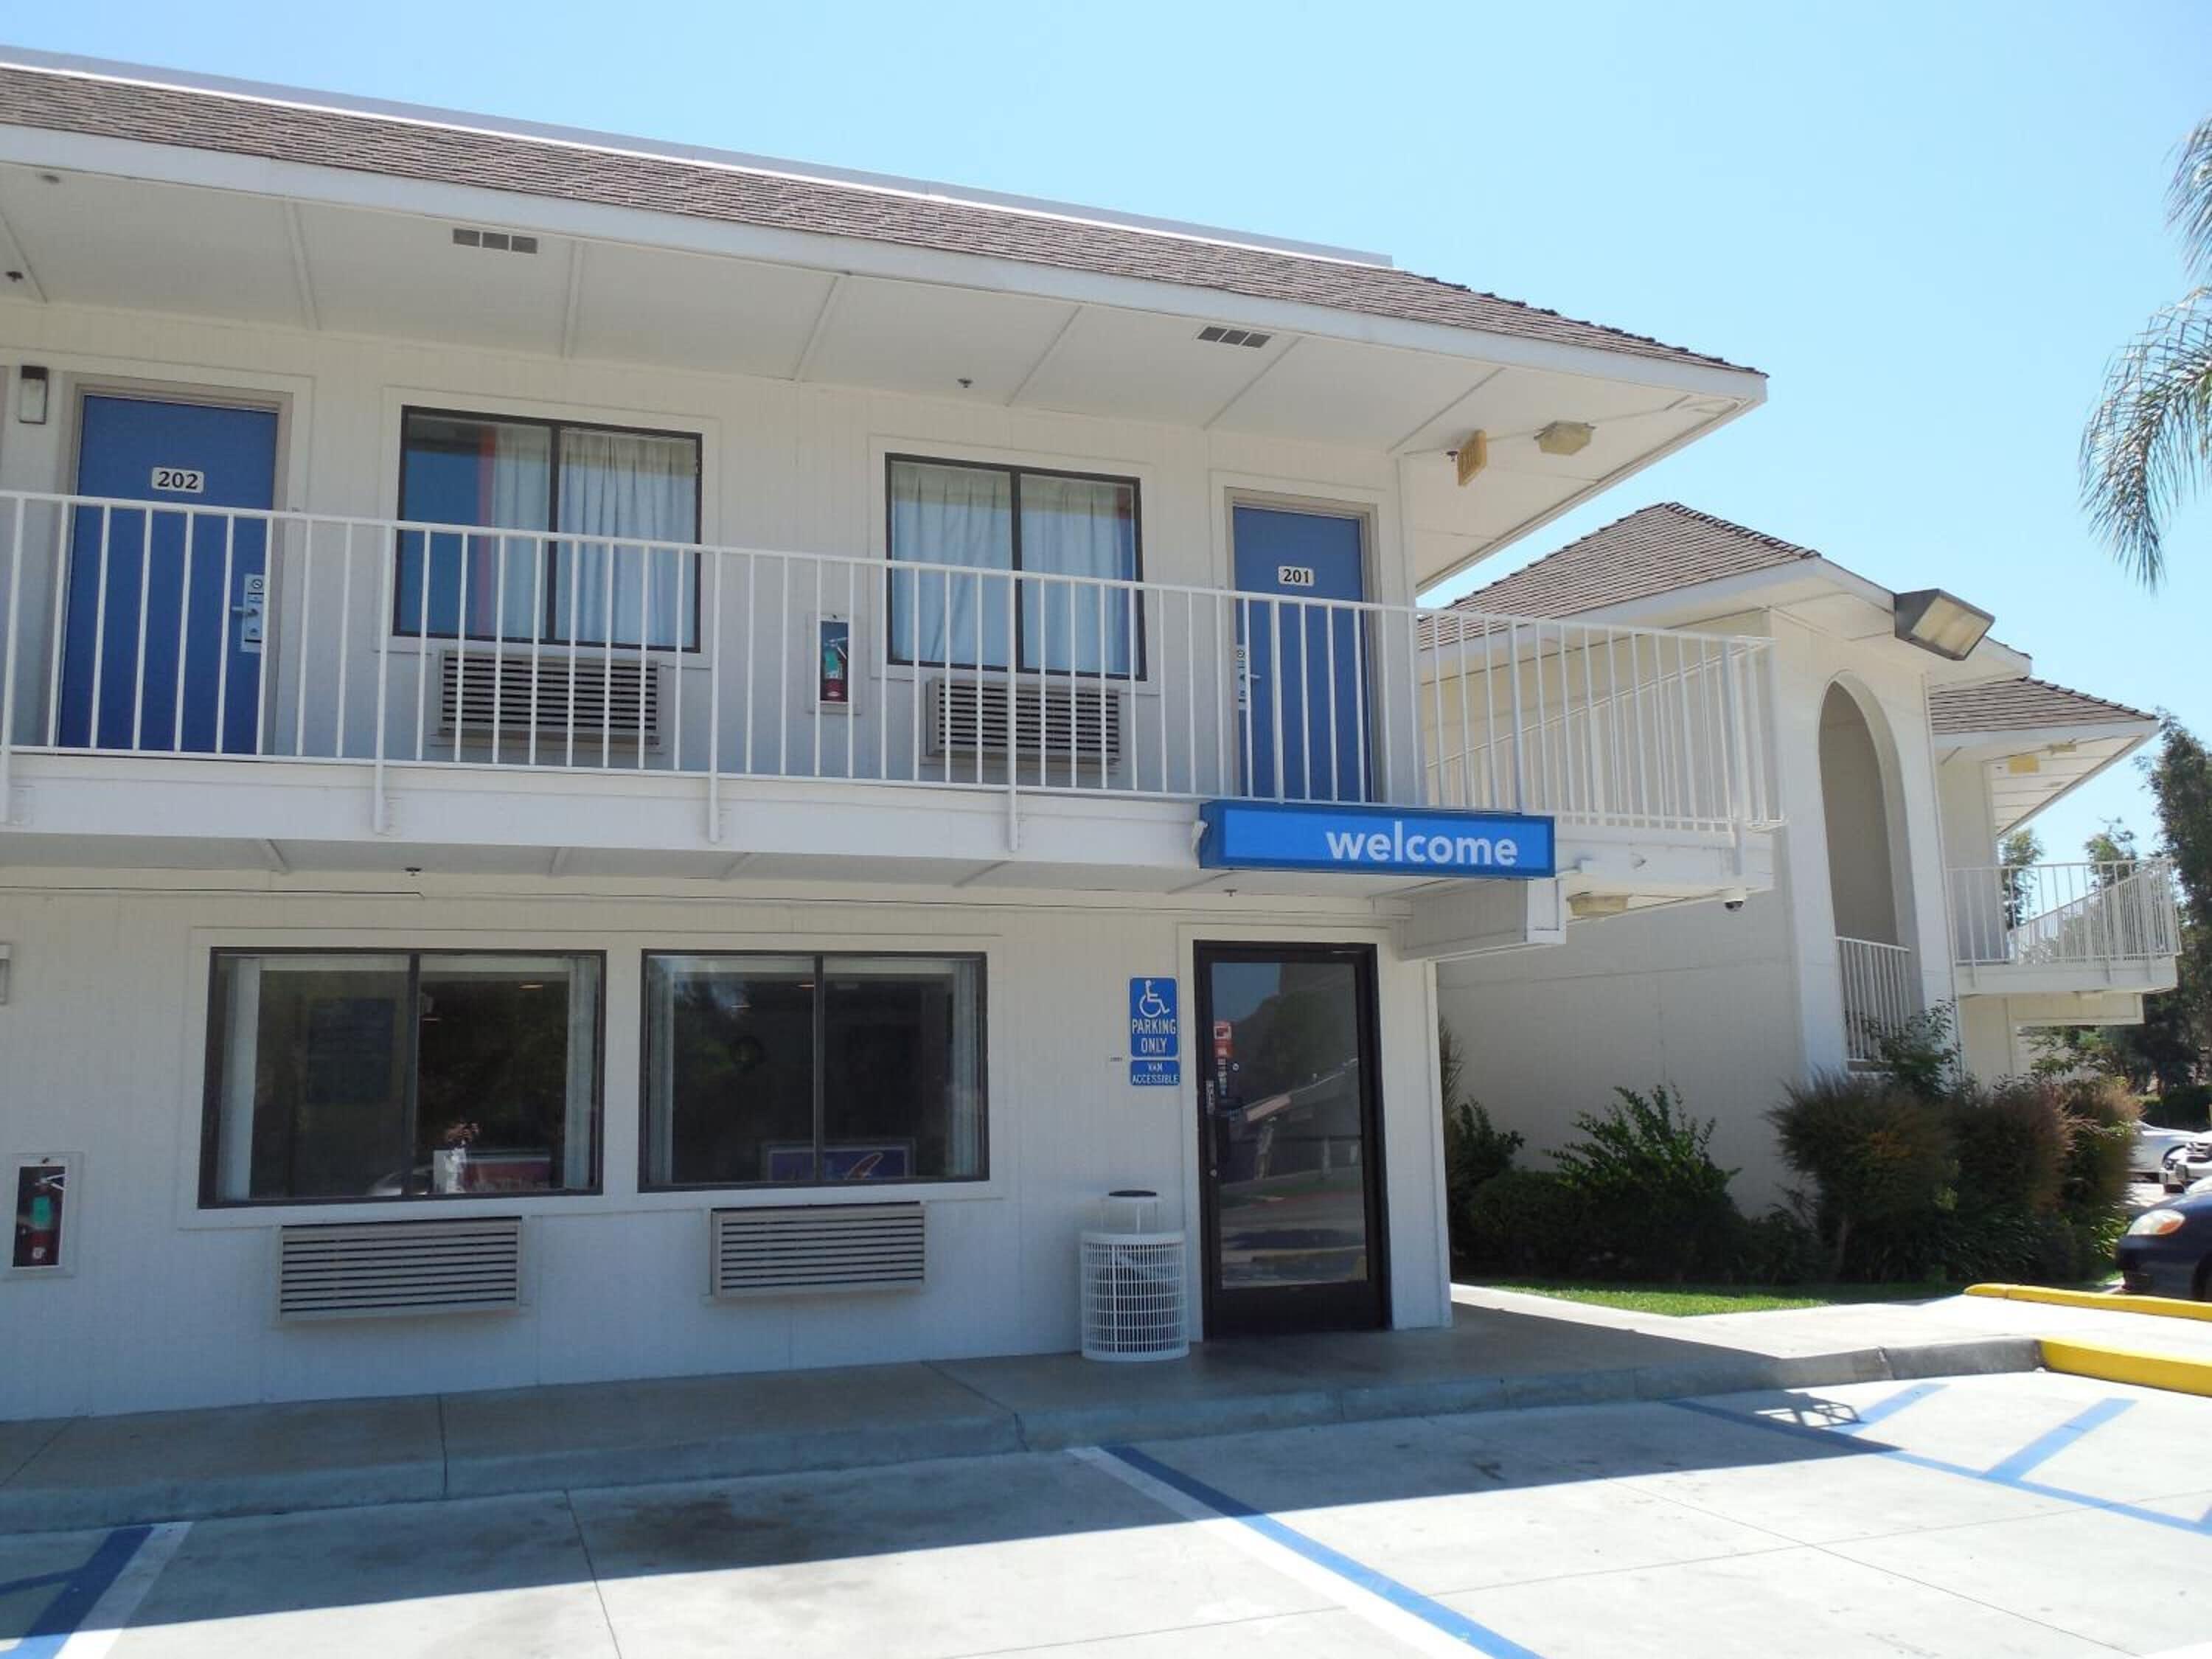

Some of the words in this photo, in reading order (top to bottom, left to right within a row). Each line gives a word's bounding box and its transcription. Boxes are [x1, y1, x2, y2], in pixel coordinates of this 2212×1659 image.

[158, 470, 198, 490] 202
[1283, 568, 1310, 584] 201
[1325, 820, 1518, 866] welcome
[1132, 1018, 1177, 1034] PARKING
[1141, 1037, 1167, 1054] ONLY
[1132, 1074, 1180, 1084] ACCESSIBLE
